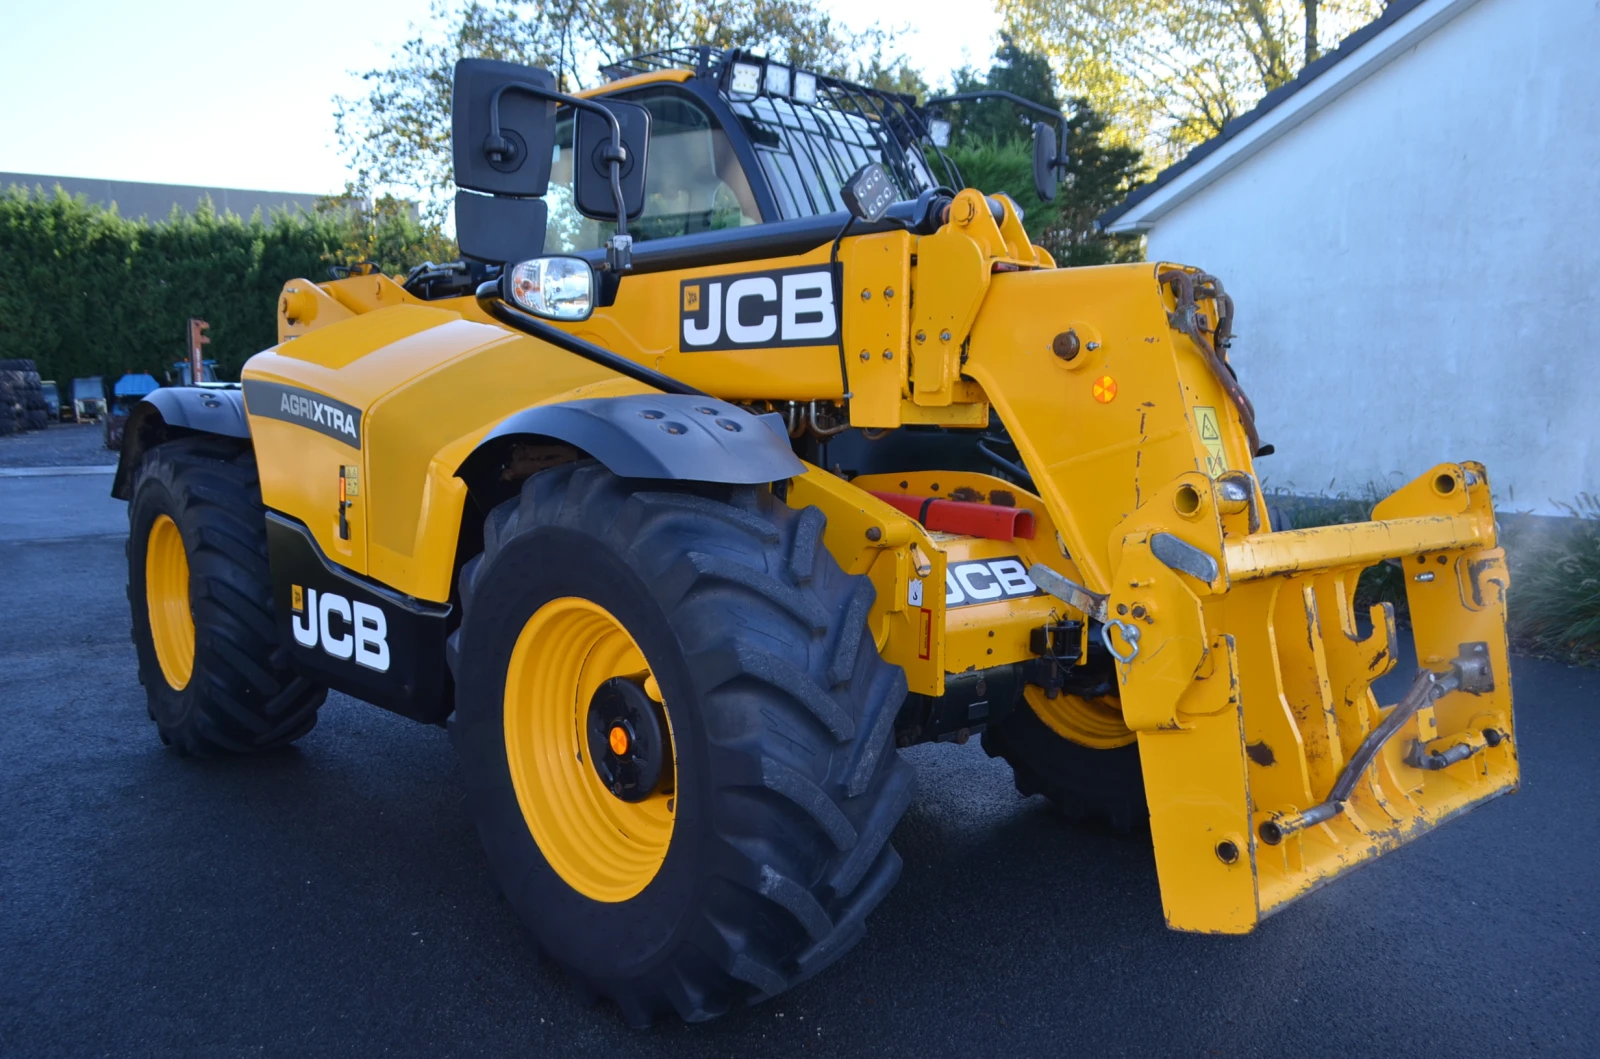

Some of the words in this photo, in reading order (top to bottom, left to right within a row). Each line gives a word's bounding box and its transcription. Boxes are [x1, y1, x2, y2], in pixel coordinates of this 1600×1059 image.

[683, 271, 837, 346] JCB
[280, 392, 357, 439] AGRIXTRA
[291, 588, 391, 673] JCB
